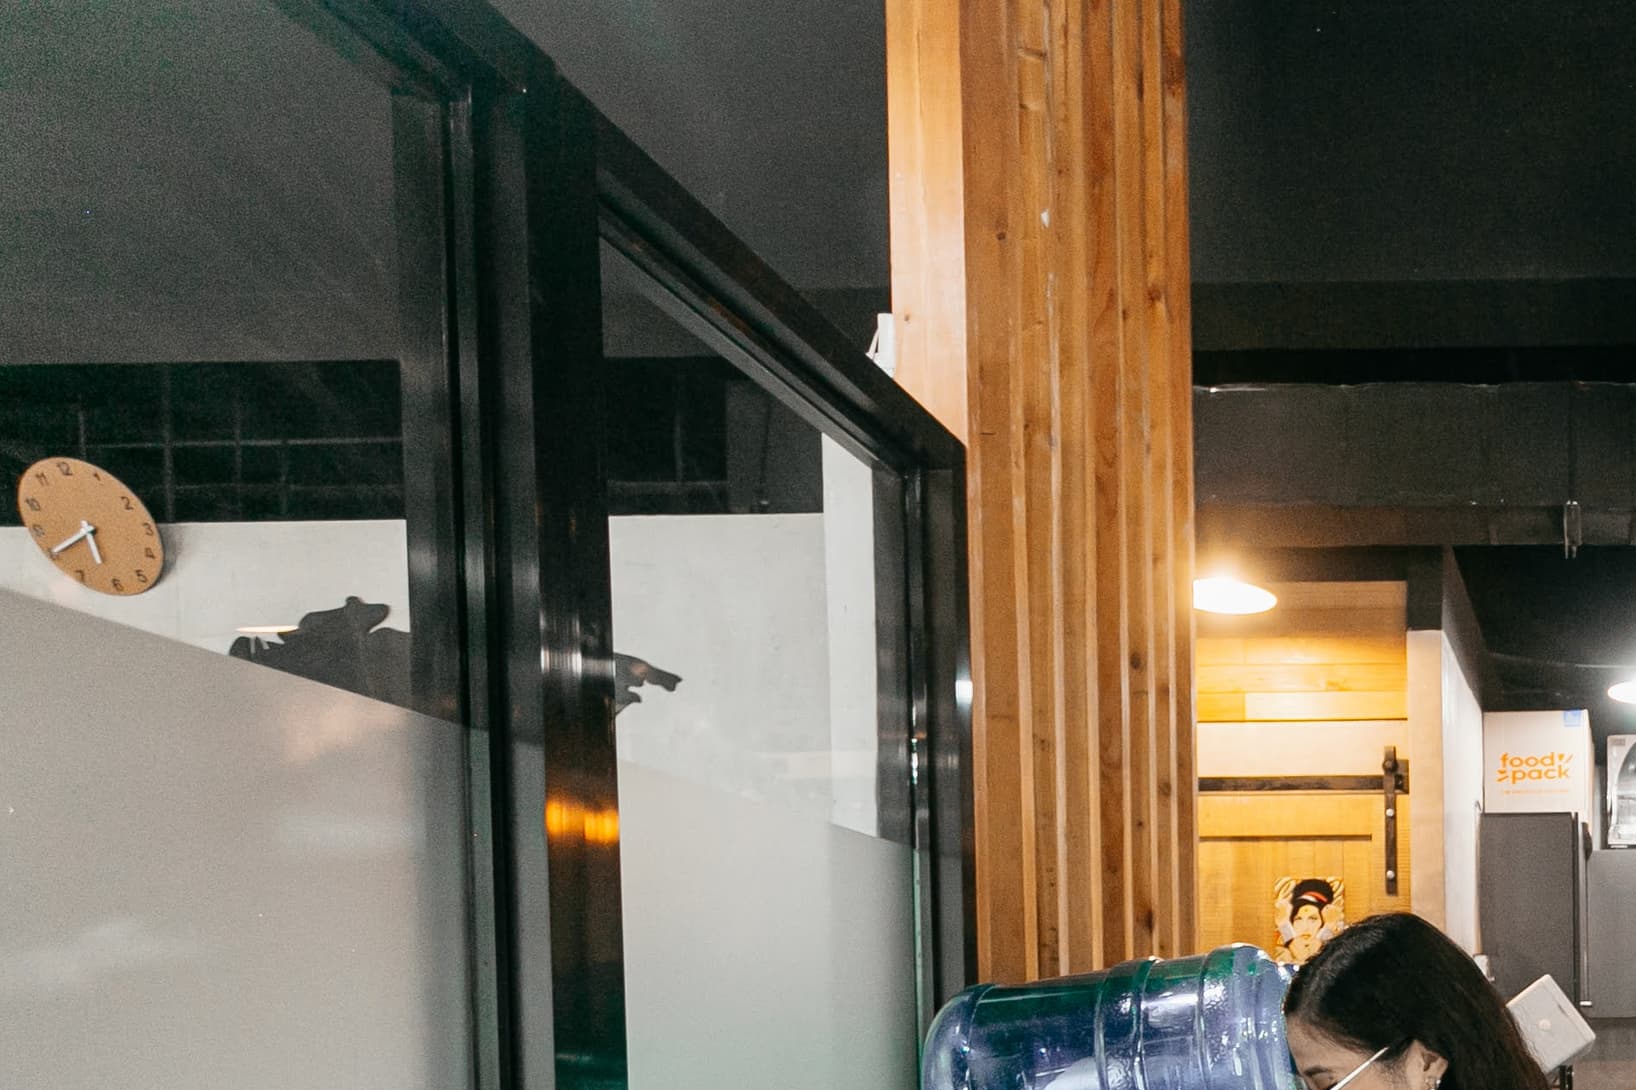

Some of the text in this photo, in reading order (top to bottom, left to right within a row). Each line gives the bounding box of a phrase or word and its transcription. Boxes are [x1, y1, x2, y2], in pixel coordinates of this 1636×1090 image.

[56, 461, 73, 476] 12
[35, 472, 49, 487] 11
[93, 472, 101, 481] 1
[24, 498, 41, 512] 10
[121, 496, 134, 510] 2
[143, 522, 154, 537] 3
[144, 547, 156, 560] 4
[75, 569, 85, 583] 7
[135, 569, 148, 583] 5
[111, 578, 124, 592] 6
[1500, 752, 1555, 768] food
[1511, 765, 1569, 784] pack
